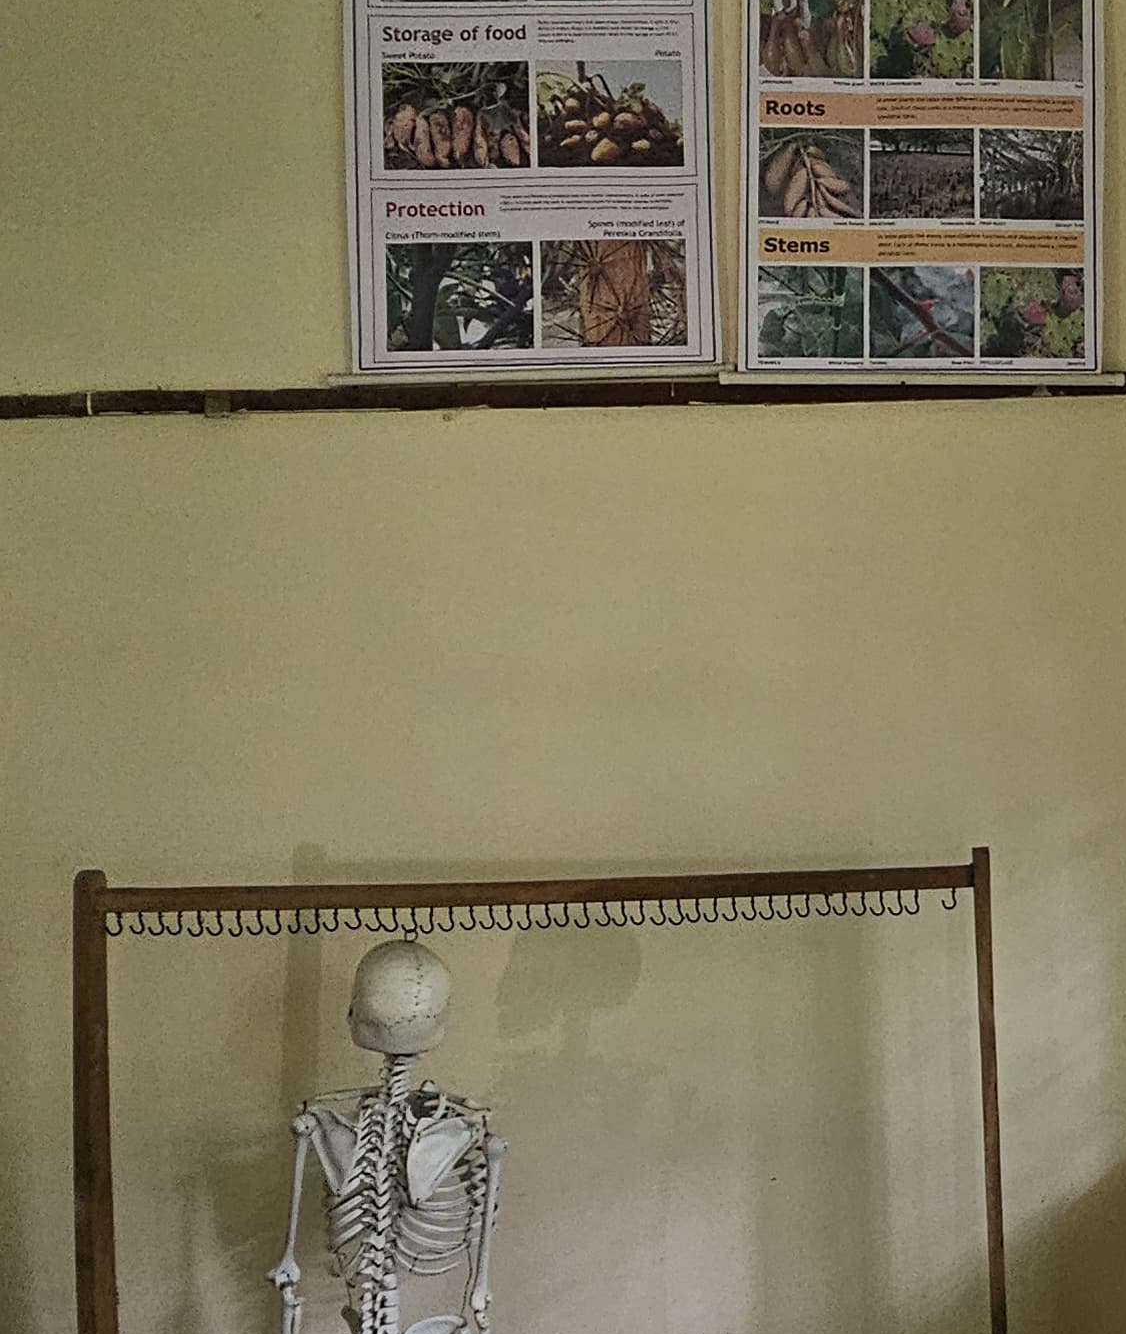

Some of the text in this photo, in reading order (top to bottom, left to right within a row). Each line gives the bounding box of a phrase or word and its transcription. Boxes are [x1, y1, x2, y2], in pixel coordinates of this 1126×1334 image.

[382, 26, 454, 45] Storage
[460, 26, 480, 41] of
[485, 25, 526, 41] food
[765, 100, 825, 117] Roots
[386, 201, 486, 218] Protection
[763, 237, 831, 254] Stems
